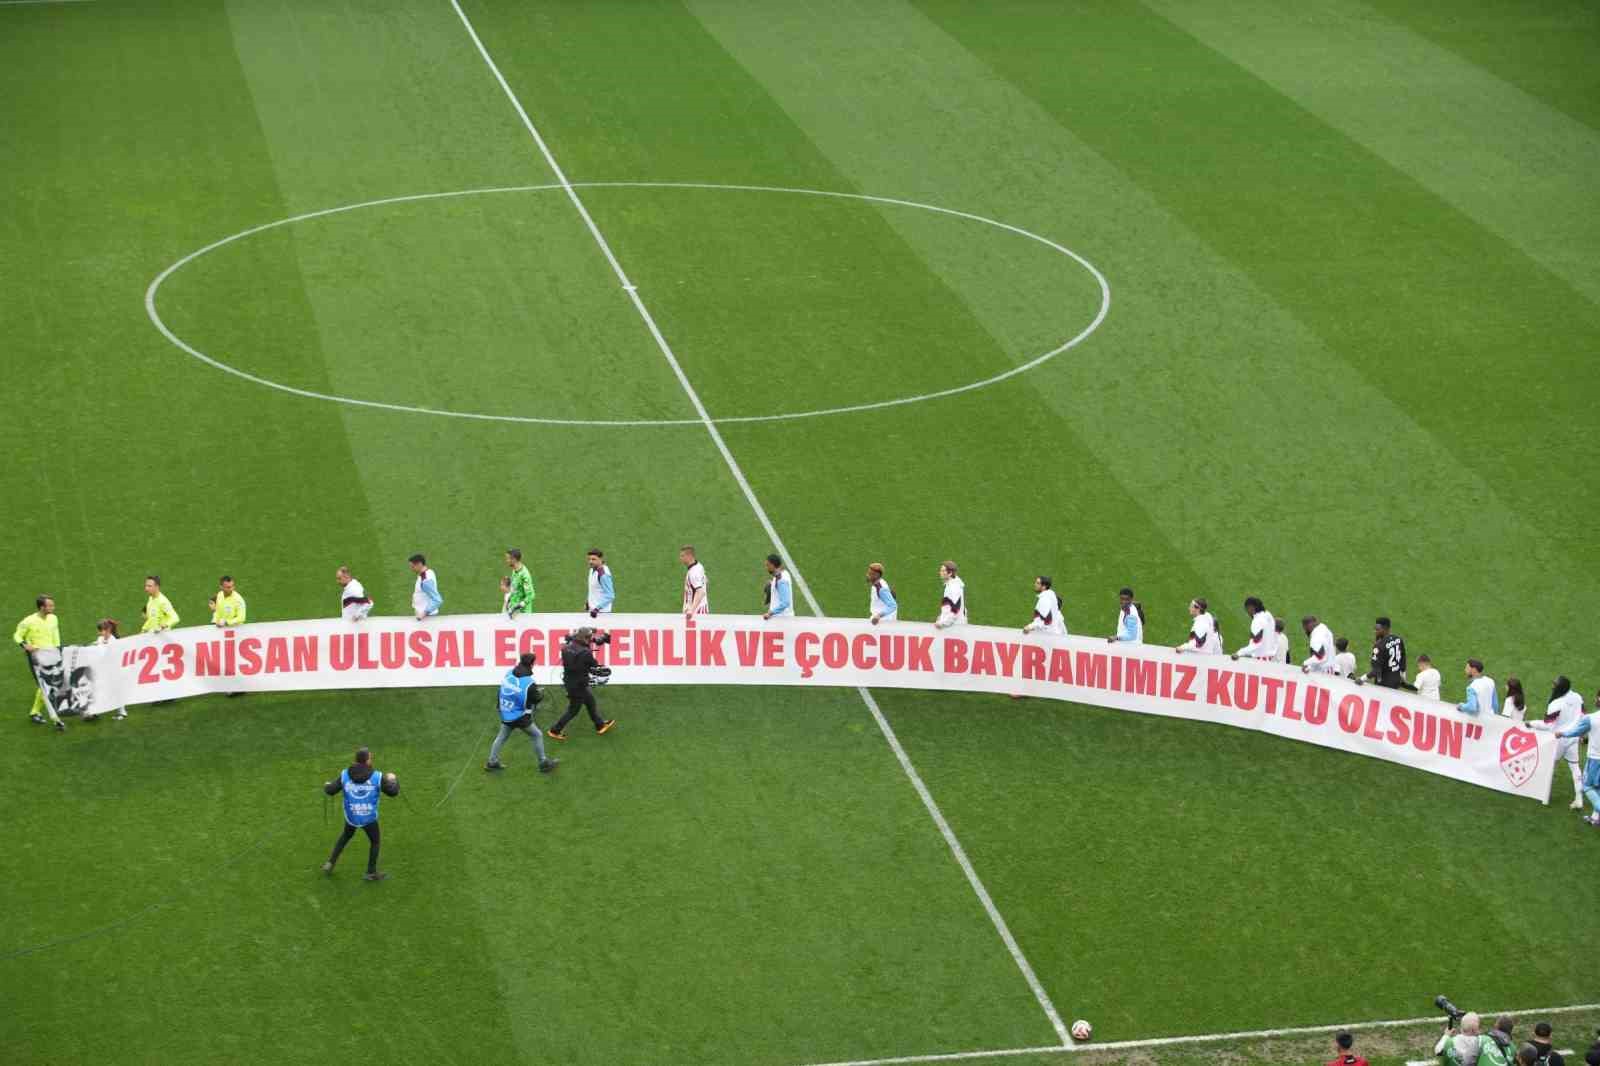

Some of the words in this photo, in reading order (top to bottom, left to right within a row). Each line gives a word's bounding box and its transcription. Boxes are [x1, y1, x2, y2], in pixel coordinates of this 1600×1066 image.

[122, 643, 185, 685] "23
[195, 630, 318, 677] NİSAN
[329, 630, 484, 672] ULUSAL
[735, 631, 785, 667] VE
[794, 632, 934, 679] ÇOCUK
[943, 638, 1197, 702] BAYRAMIMIZ
[1206, 669, 1330, 725] KUTLU
[1338, 694, 1483, 759] OLSUN"
